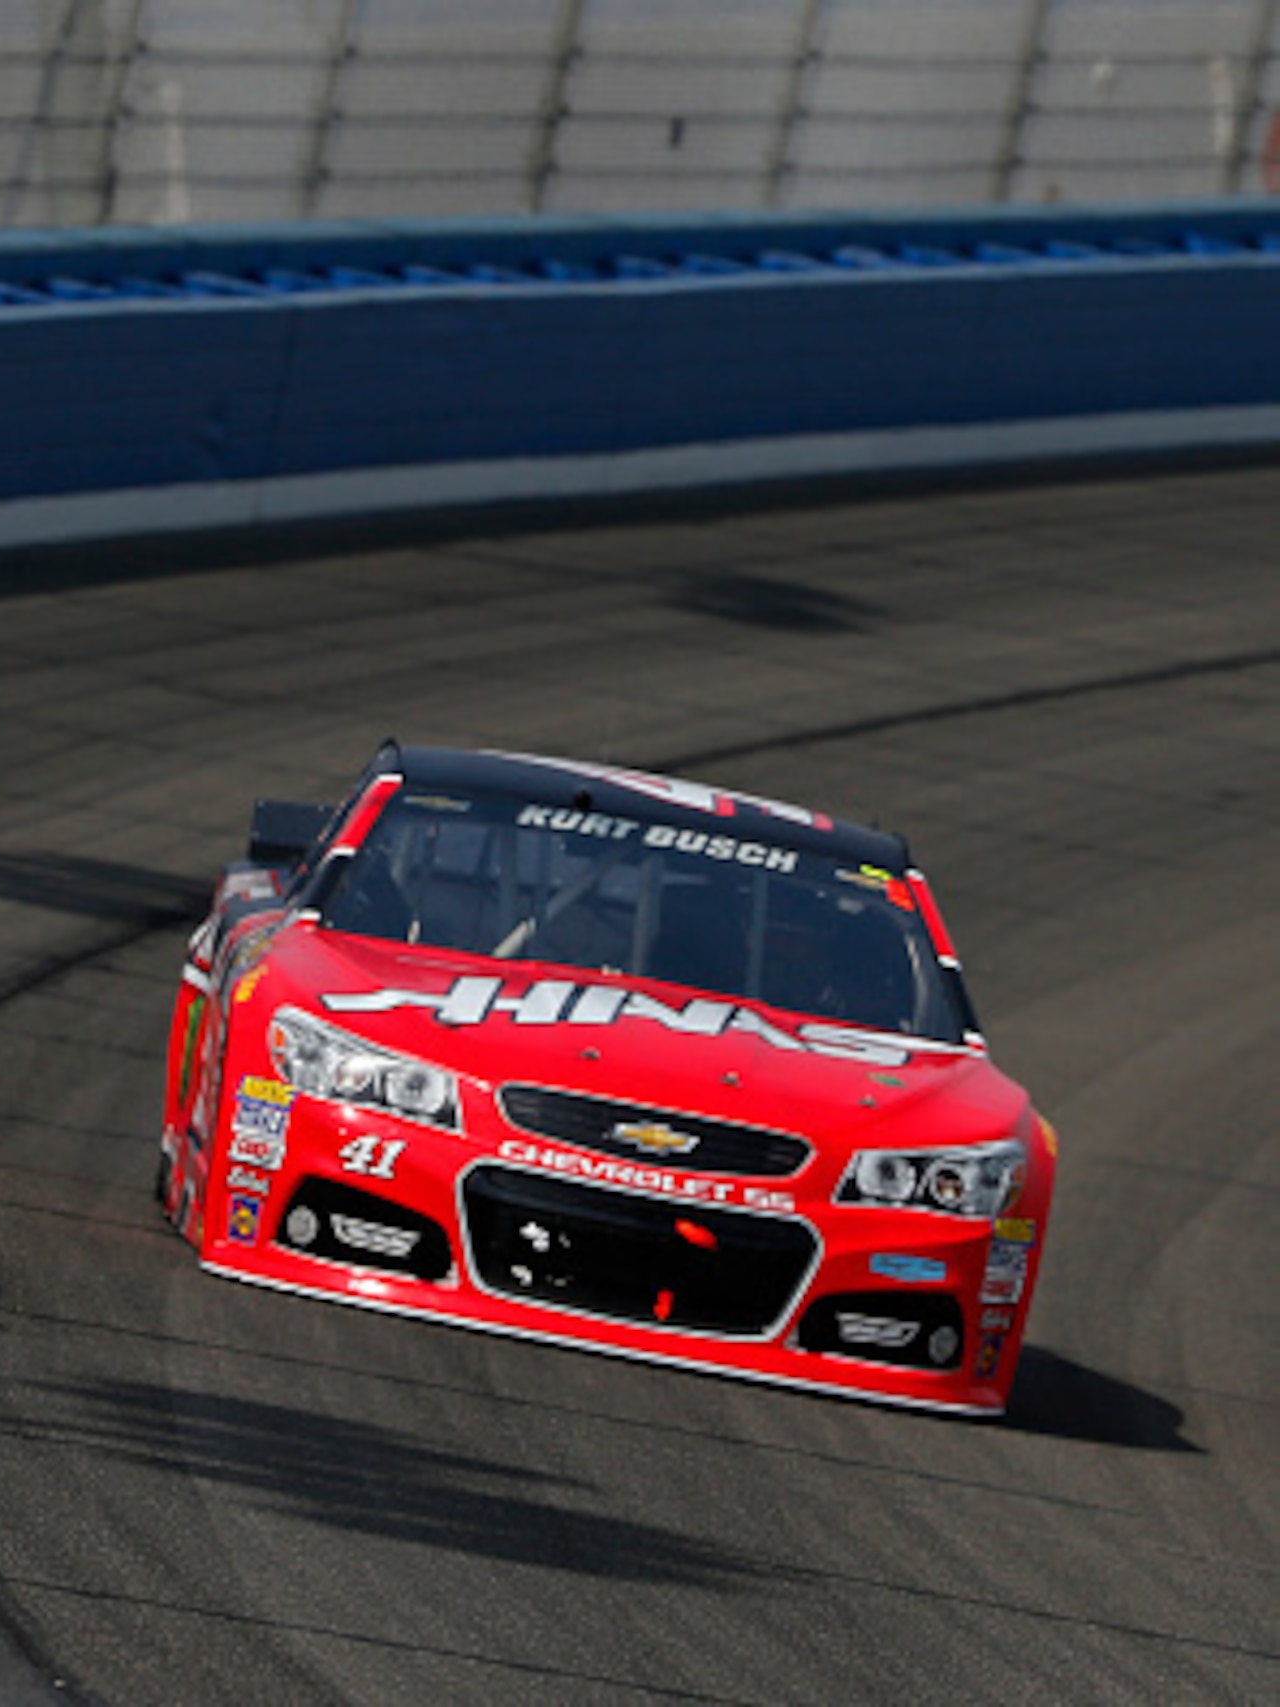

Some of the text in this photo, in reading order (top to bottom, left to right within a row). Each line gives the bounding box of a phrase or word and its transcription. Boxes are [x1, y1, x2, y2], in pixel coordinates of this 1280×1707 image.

[516, 804, 801, 874] KURT BUSCH
[338, 1134, 408, 1179] 41
[498, 1140, 797, 1214] CHEVROLET SS
